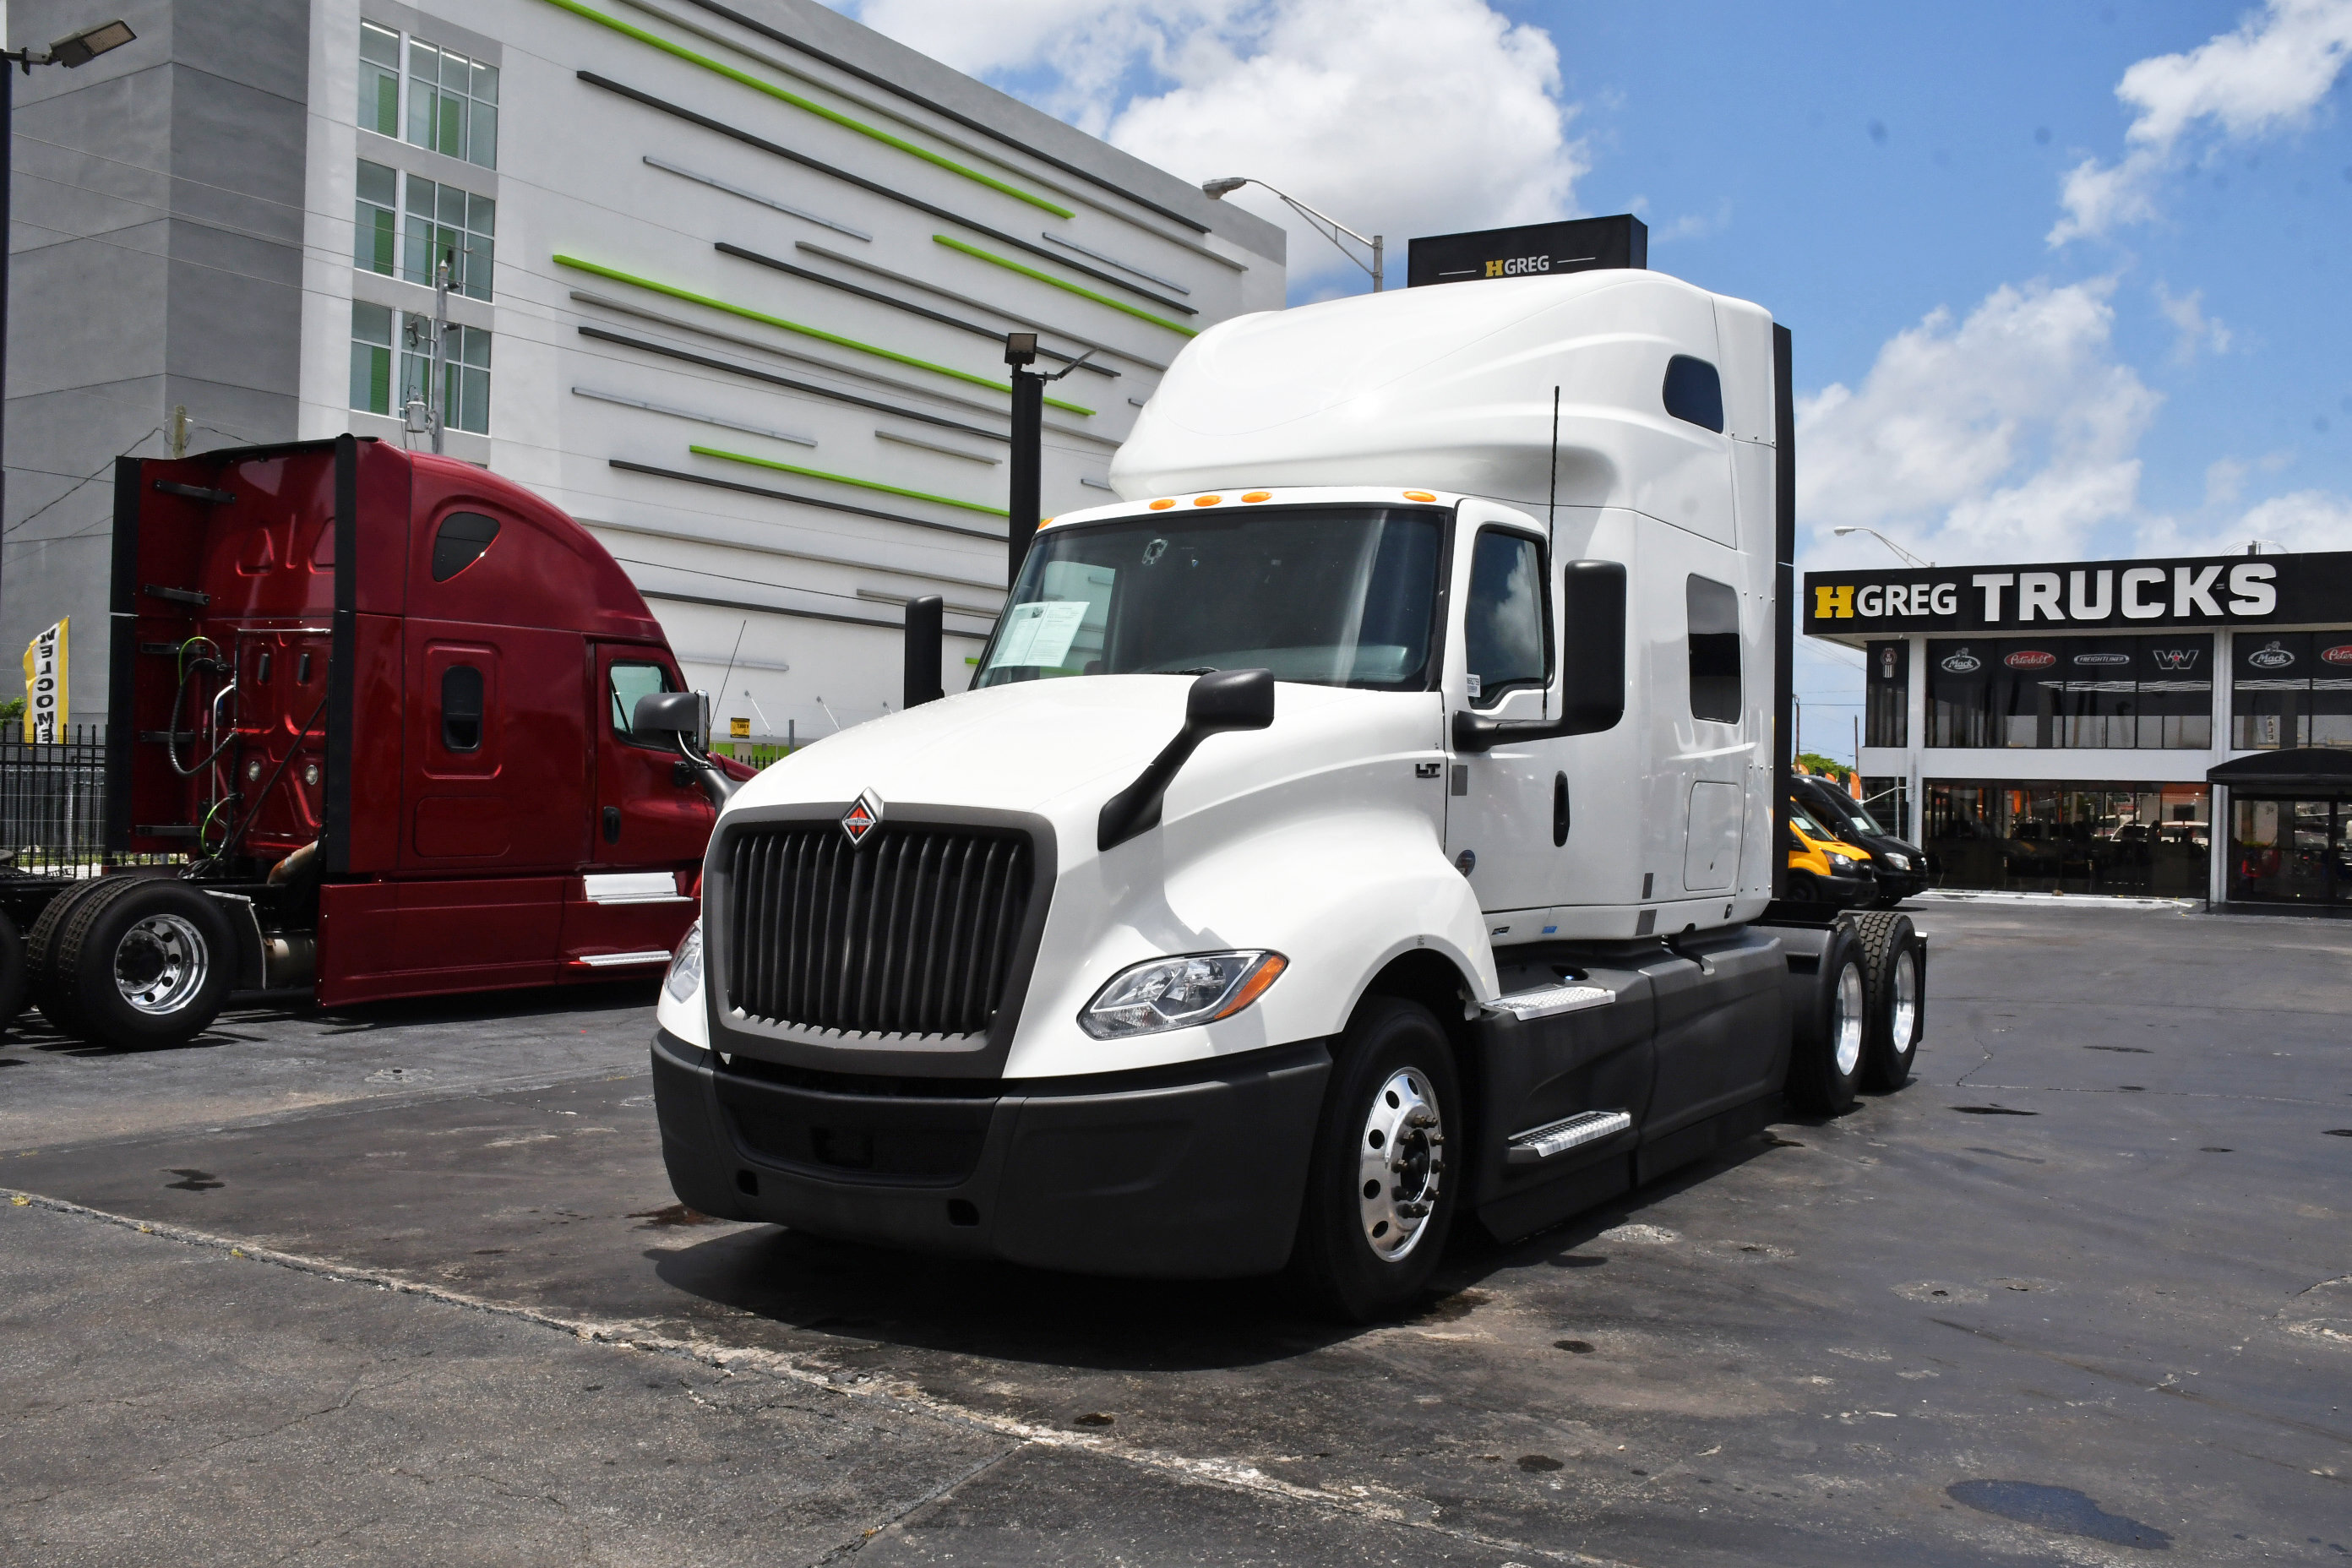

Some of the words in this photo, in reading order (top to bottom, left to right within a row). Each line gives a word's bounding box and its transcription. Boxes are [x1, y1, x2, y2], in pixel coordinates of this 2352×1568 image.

[1485, 255, 1549, 277] HGREG
[1815, 583, 1957, 618] HGREG
[1972, 563, 2277, 622] TRUCKS
[1948, 659, 1974, 669] Mack
[2010, 654, 2051, 665] Peterbilt
[2257, 653, 2286, 665] Mack
[1415, 763, 1440, 776] LT
